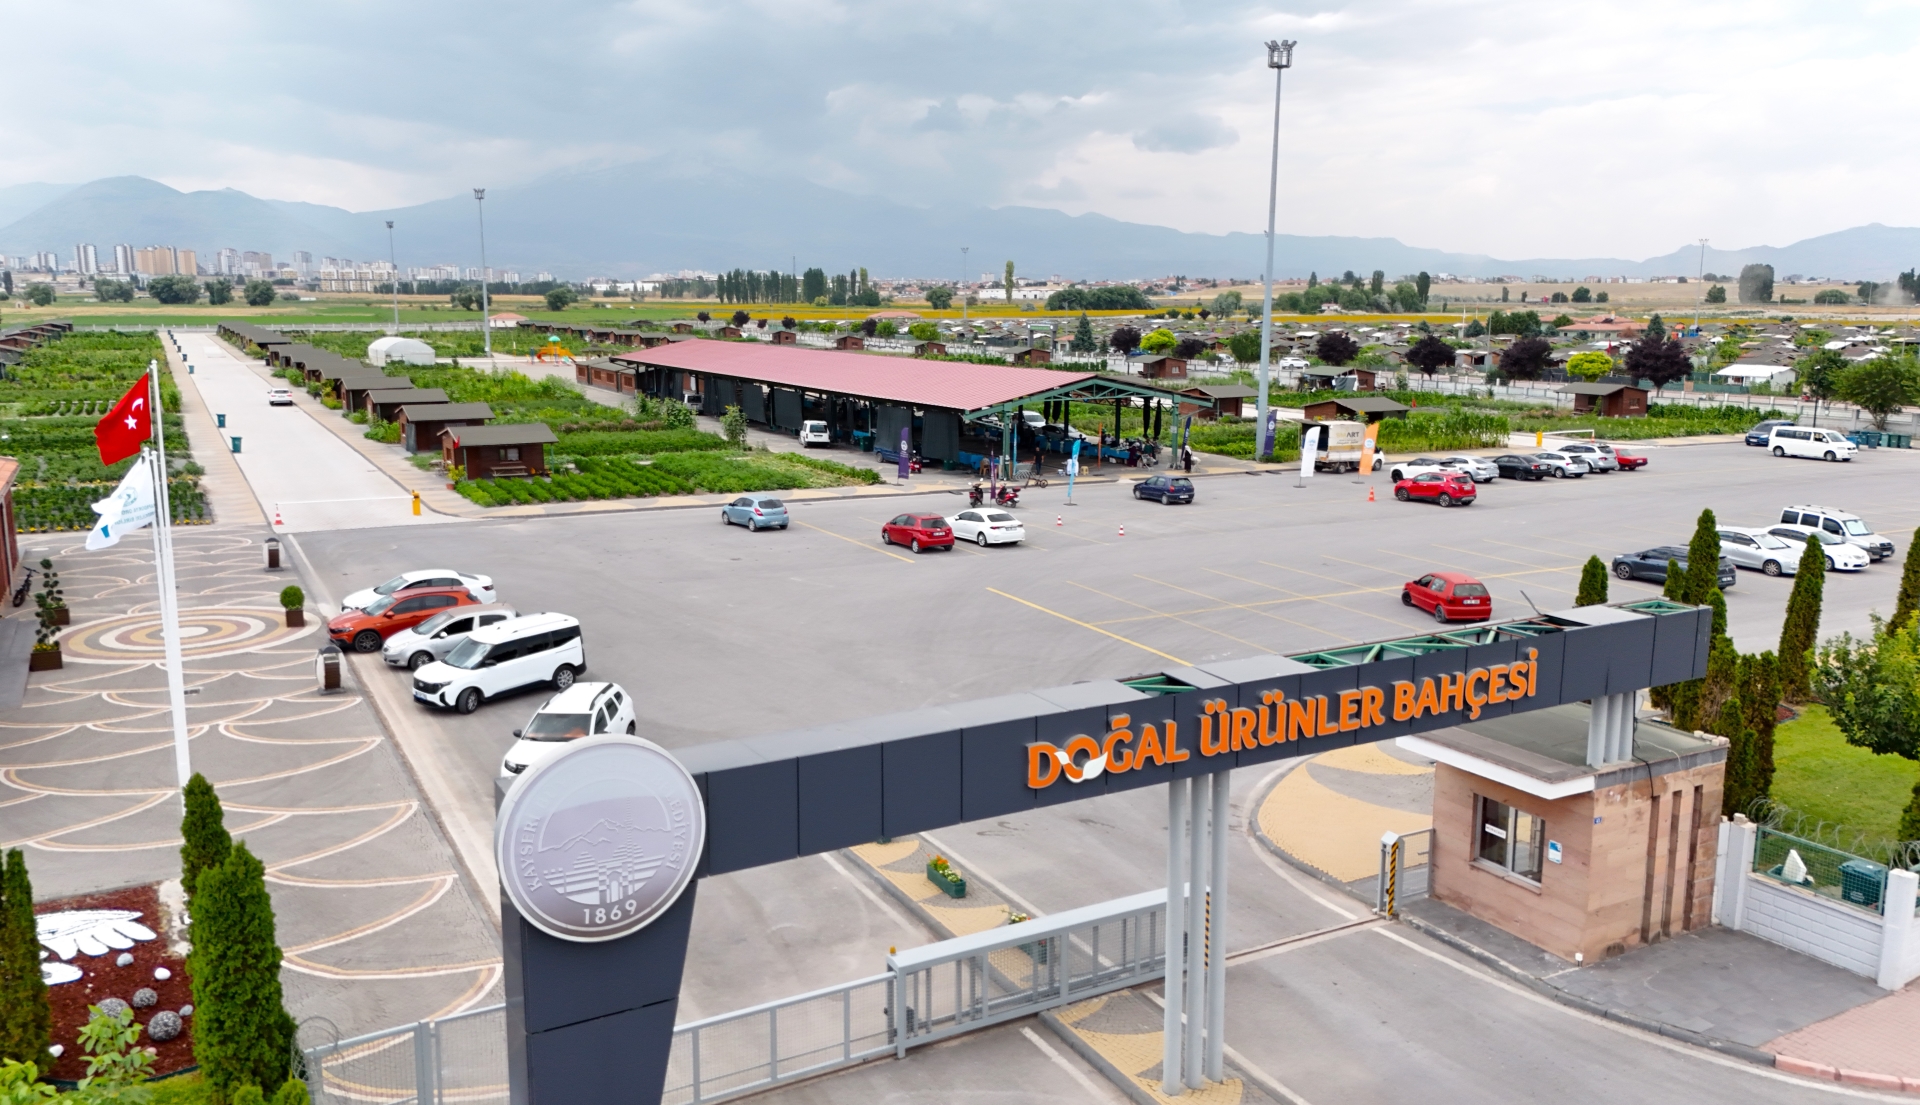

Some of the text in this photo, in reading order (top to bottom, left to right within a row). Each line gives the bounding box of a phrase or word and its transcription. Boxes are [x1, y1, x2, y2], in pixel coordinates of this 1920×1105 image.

[1027, 647, 1538, 789] DOĞAL ÜRÜNLER BAHÇESİ
[658, 776, 690, 871] LEDİYESİ
[583, 899, 637, 925] 1869
